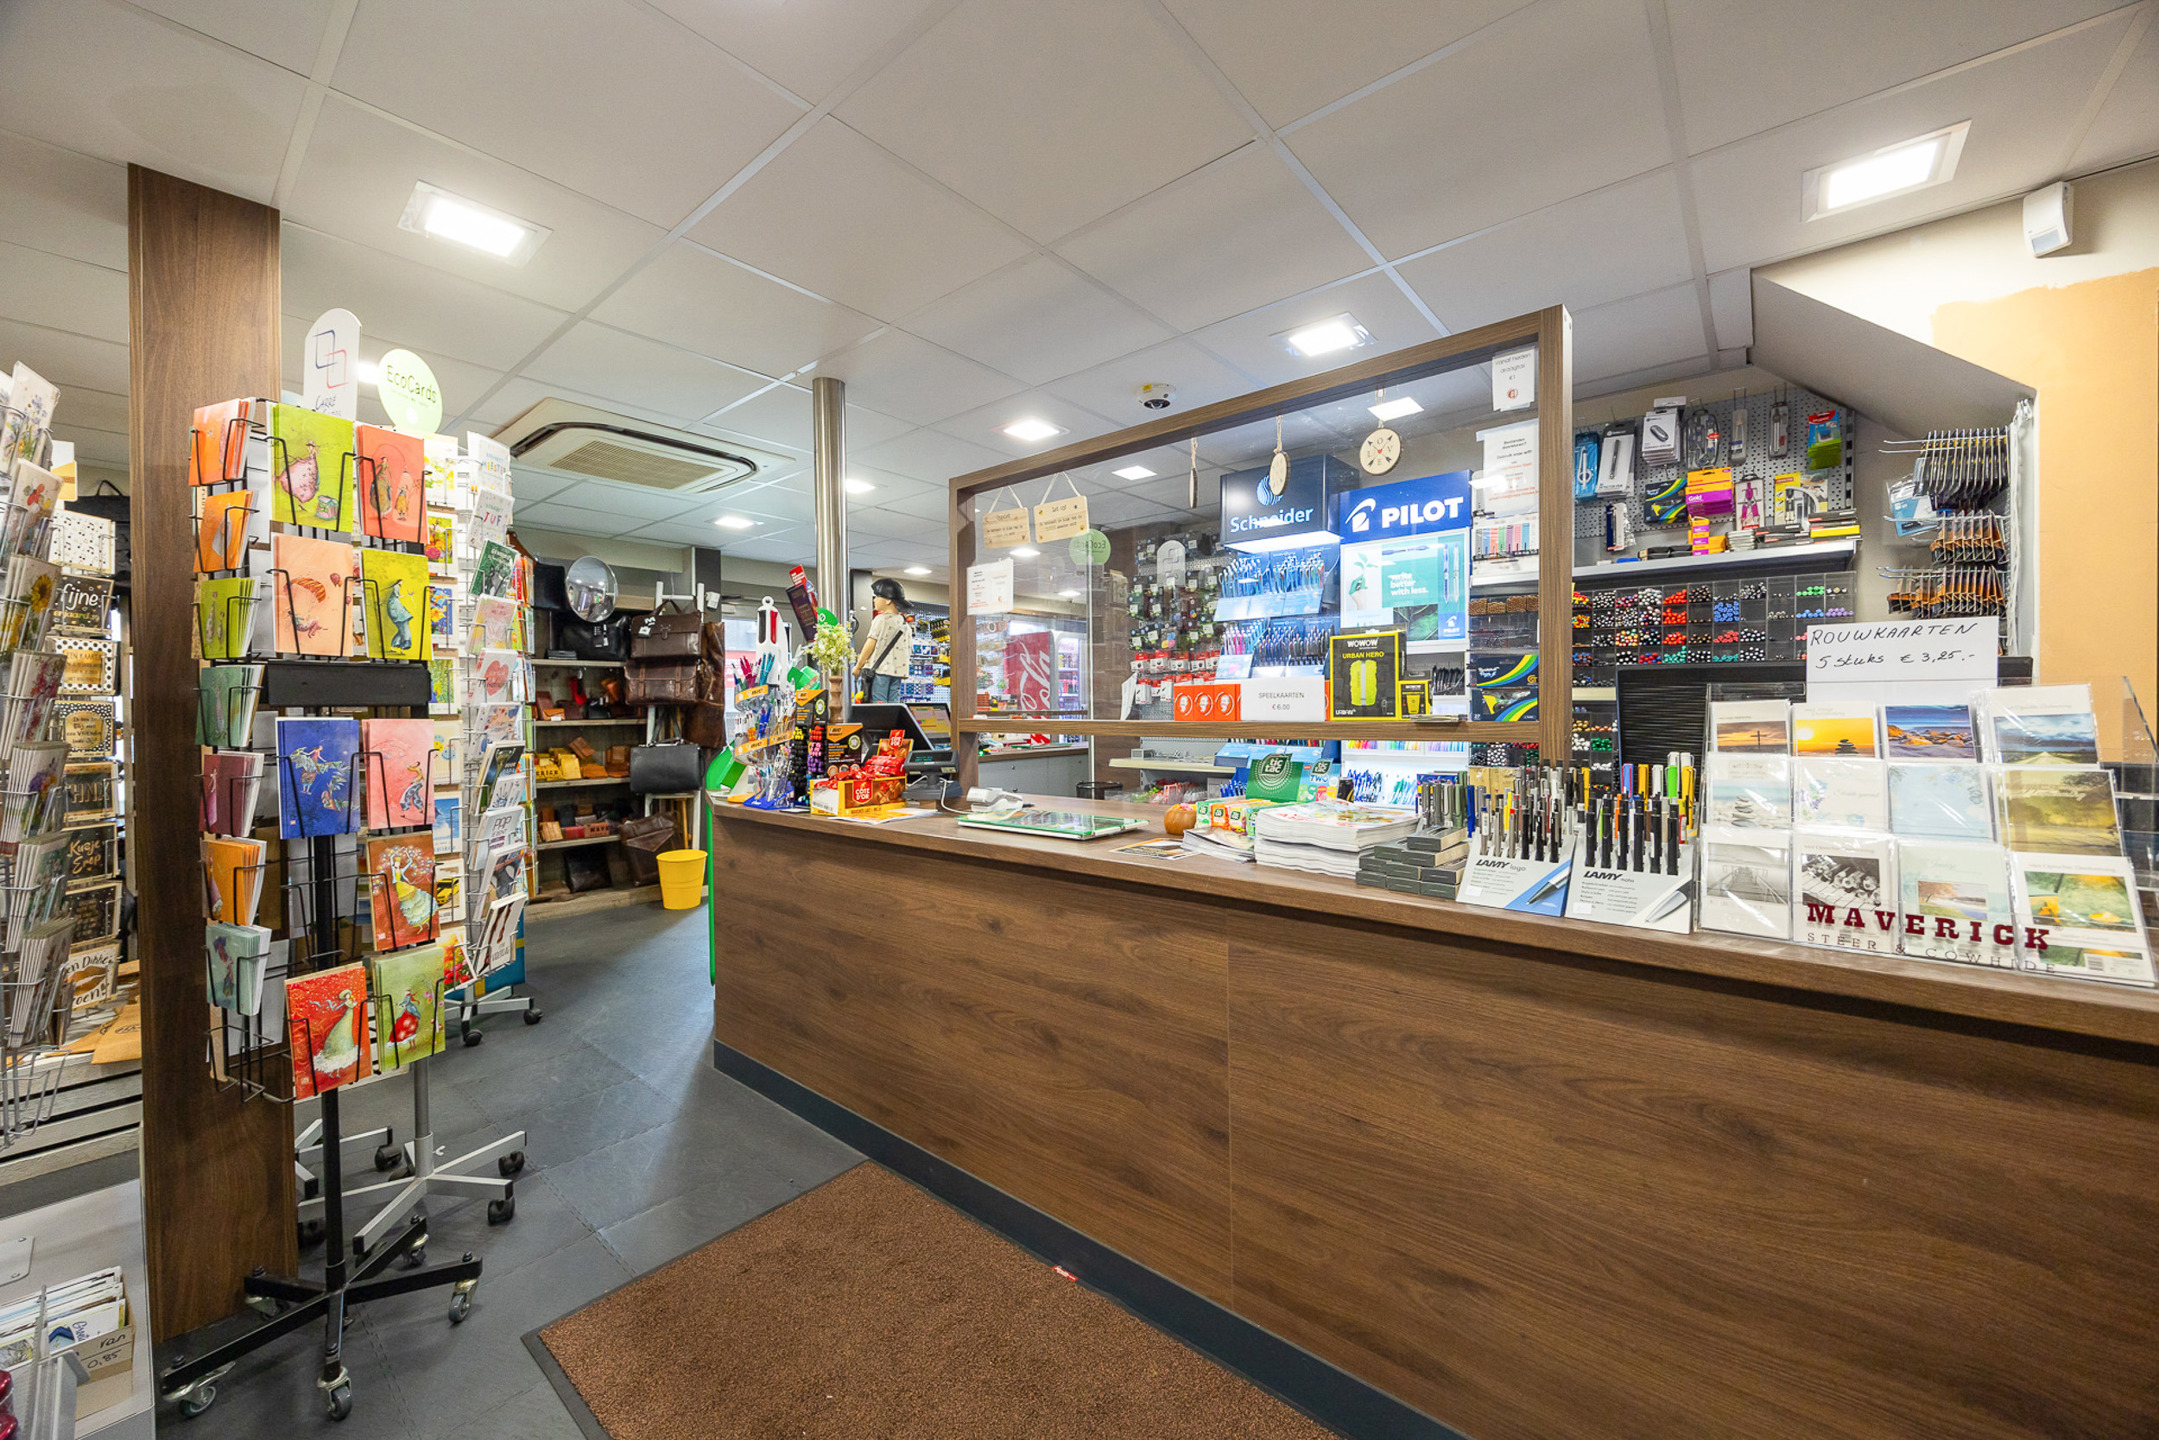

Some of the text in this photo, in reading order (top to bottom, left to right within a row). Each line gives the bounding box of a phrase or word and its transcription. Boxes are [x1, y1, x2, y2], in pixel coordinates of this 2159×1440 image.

[387, 365, 437, 404] EcoCards
[1688, 494, 1703, 502] Gold
[483, 511, 502, 526] JUF
[1381, 496, 1464, 529] PILOT
[60, 583, 99, 611] fijne
[1391, 588, 1410, 596] with
[1810, 622, 1978, 646] ROUWKAARTEN
[1347, 638, 1379, 648] WOWOW
[1815, 655, 1831, 669] 5
[1834, 653, 1884, 668] stuks
[1900, 654, 1914, 664] €
[1270, 757, 1283, 767] tic
[1264, 765, 1281, 773] tac
[1311, 774, 1329, 783] TWO
[855, 786, 870, 795] CÔTE
[856, 793, 870, 801] D'OR
[1476, 859, 1527, 873] LAMY logo
[1583, 870, 1623, 881] LAMY
[1807, 903, 2050, 950] MAVERICK
[1807, 932, 2056, 974] STEER & COWHIDE
